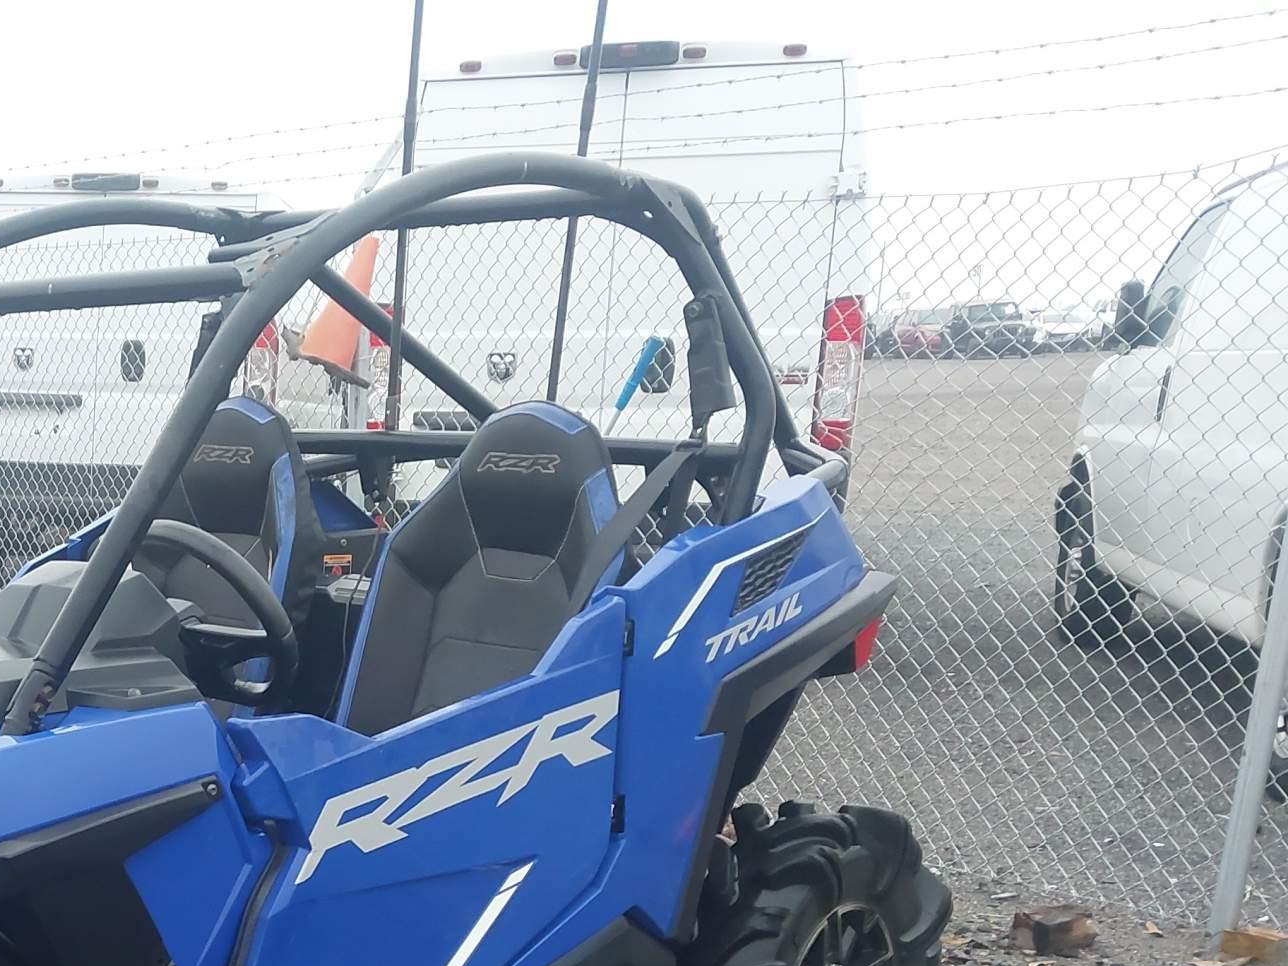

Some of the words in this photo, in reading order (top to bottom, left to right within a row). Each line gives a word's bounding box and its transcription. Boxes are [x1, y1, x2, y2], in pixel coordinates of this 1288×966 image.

[193, 443, 254, 465] RZR
[476, 451, 561, 474] RZR
[705, 591, 803, 664] TRAIL
[294, 689, 621, 886] RZR
